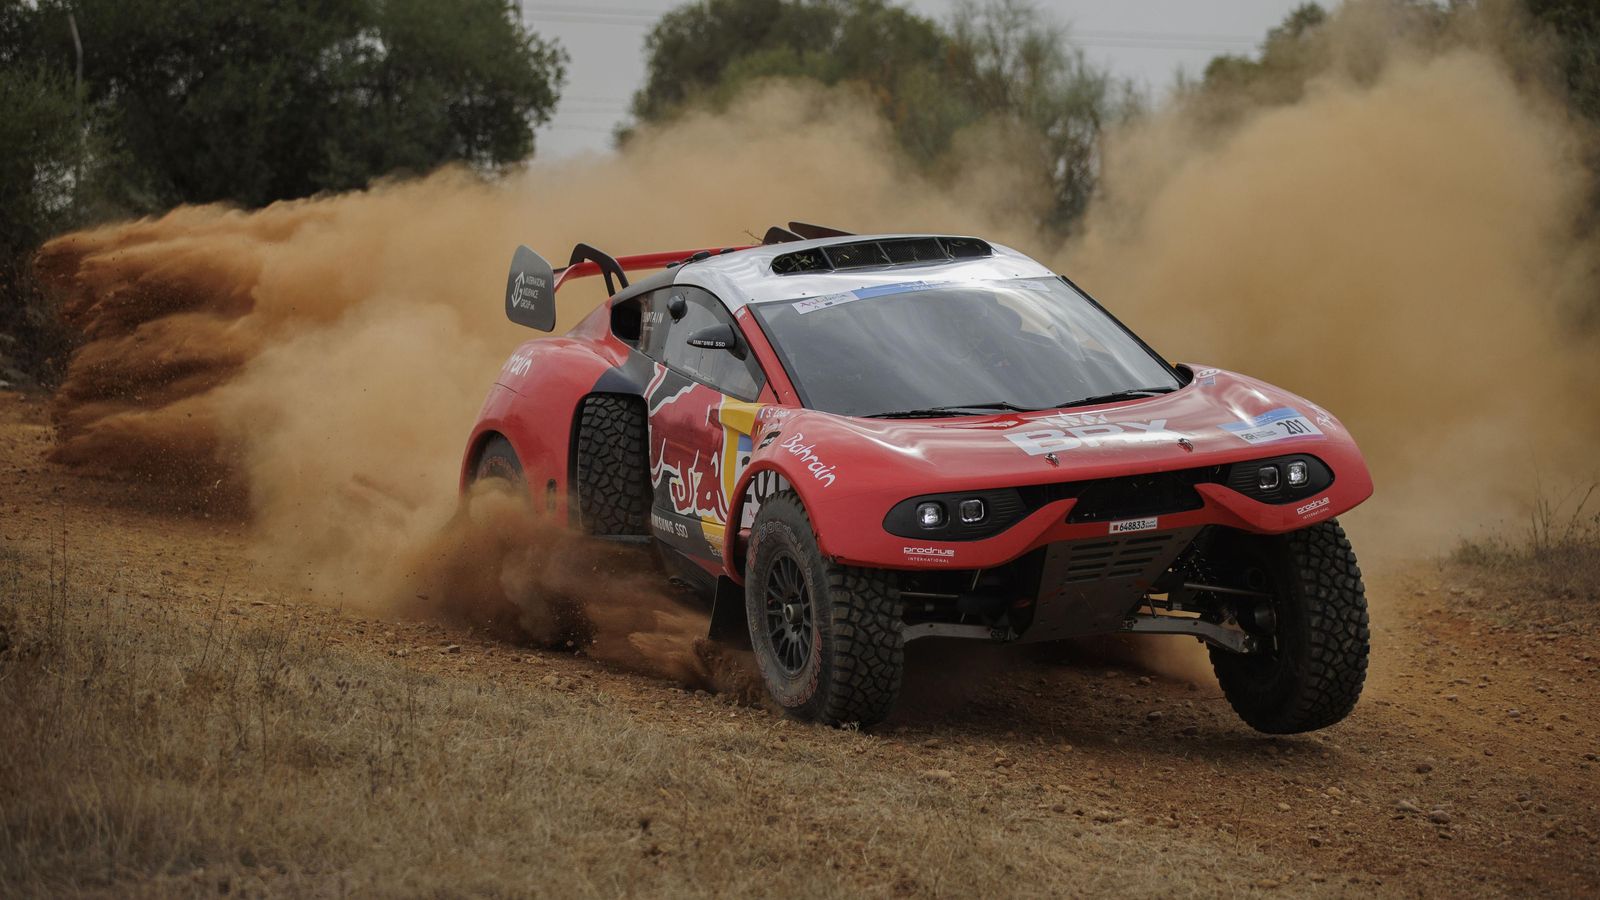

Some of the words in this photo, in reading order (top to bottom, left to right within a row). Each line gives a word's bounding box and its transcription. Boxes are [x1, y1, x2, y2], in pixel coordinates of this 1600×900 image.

[1276, 419, 1312, 436] 201
[780, 432, 836, 488] Bahrain
[1296, 496, 1330, 515] prodrive
[674, 522, 689, 539] SSD
[1120, 520, 1146, 532] 648833
[903, 546, 955, 557] prodrive
[907, 556, 950, 564] INTERNATIONAL
